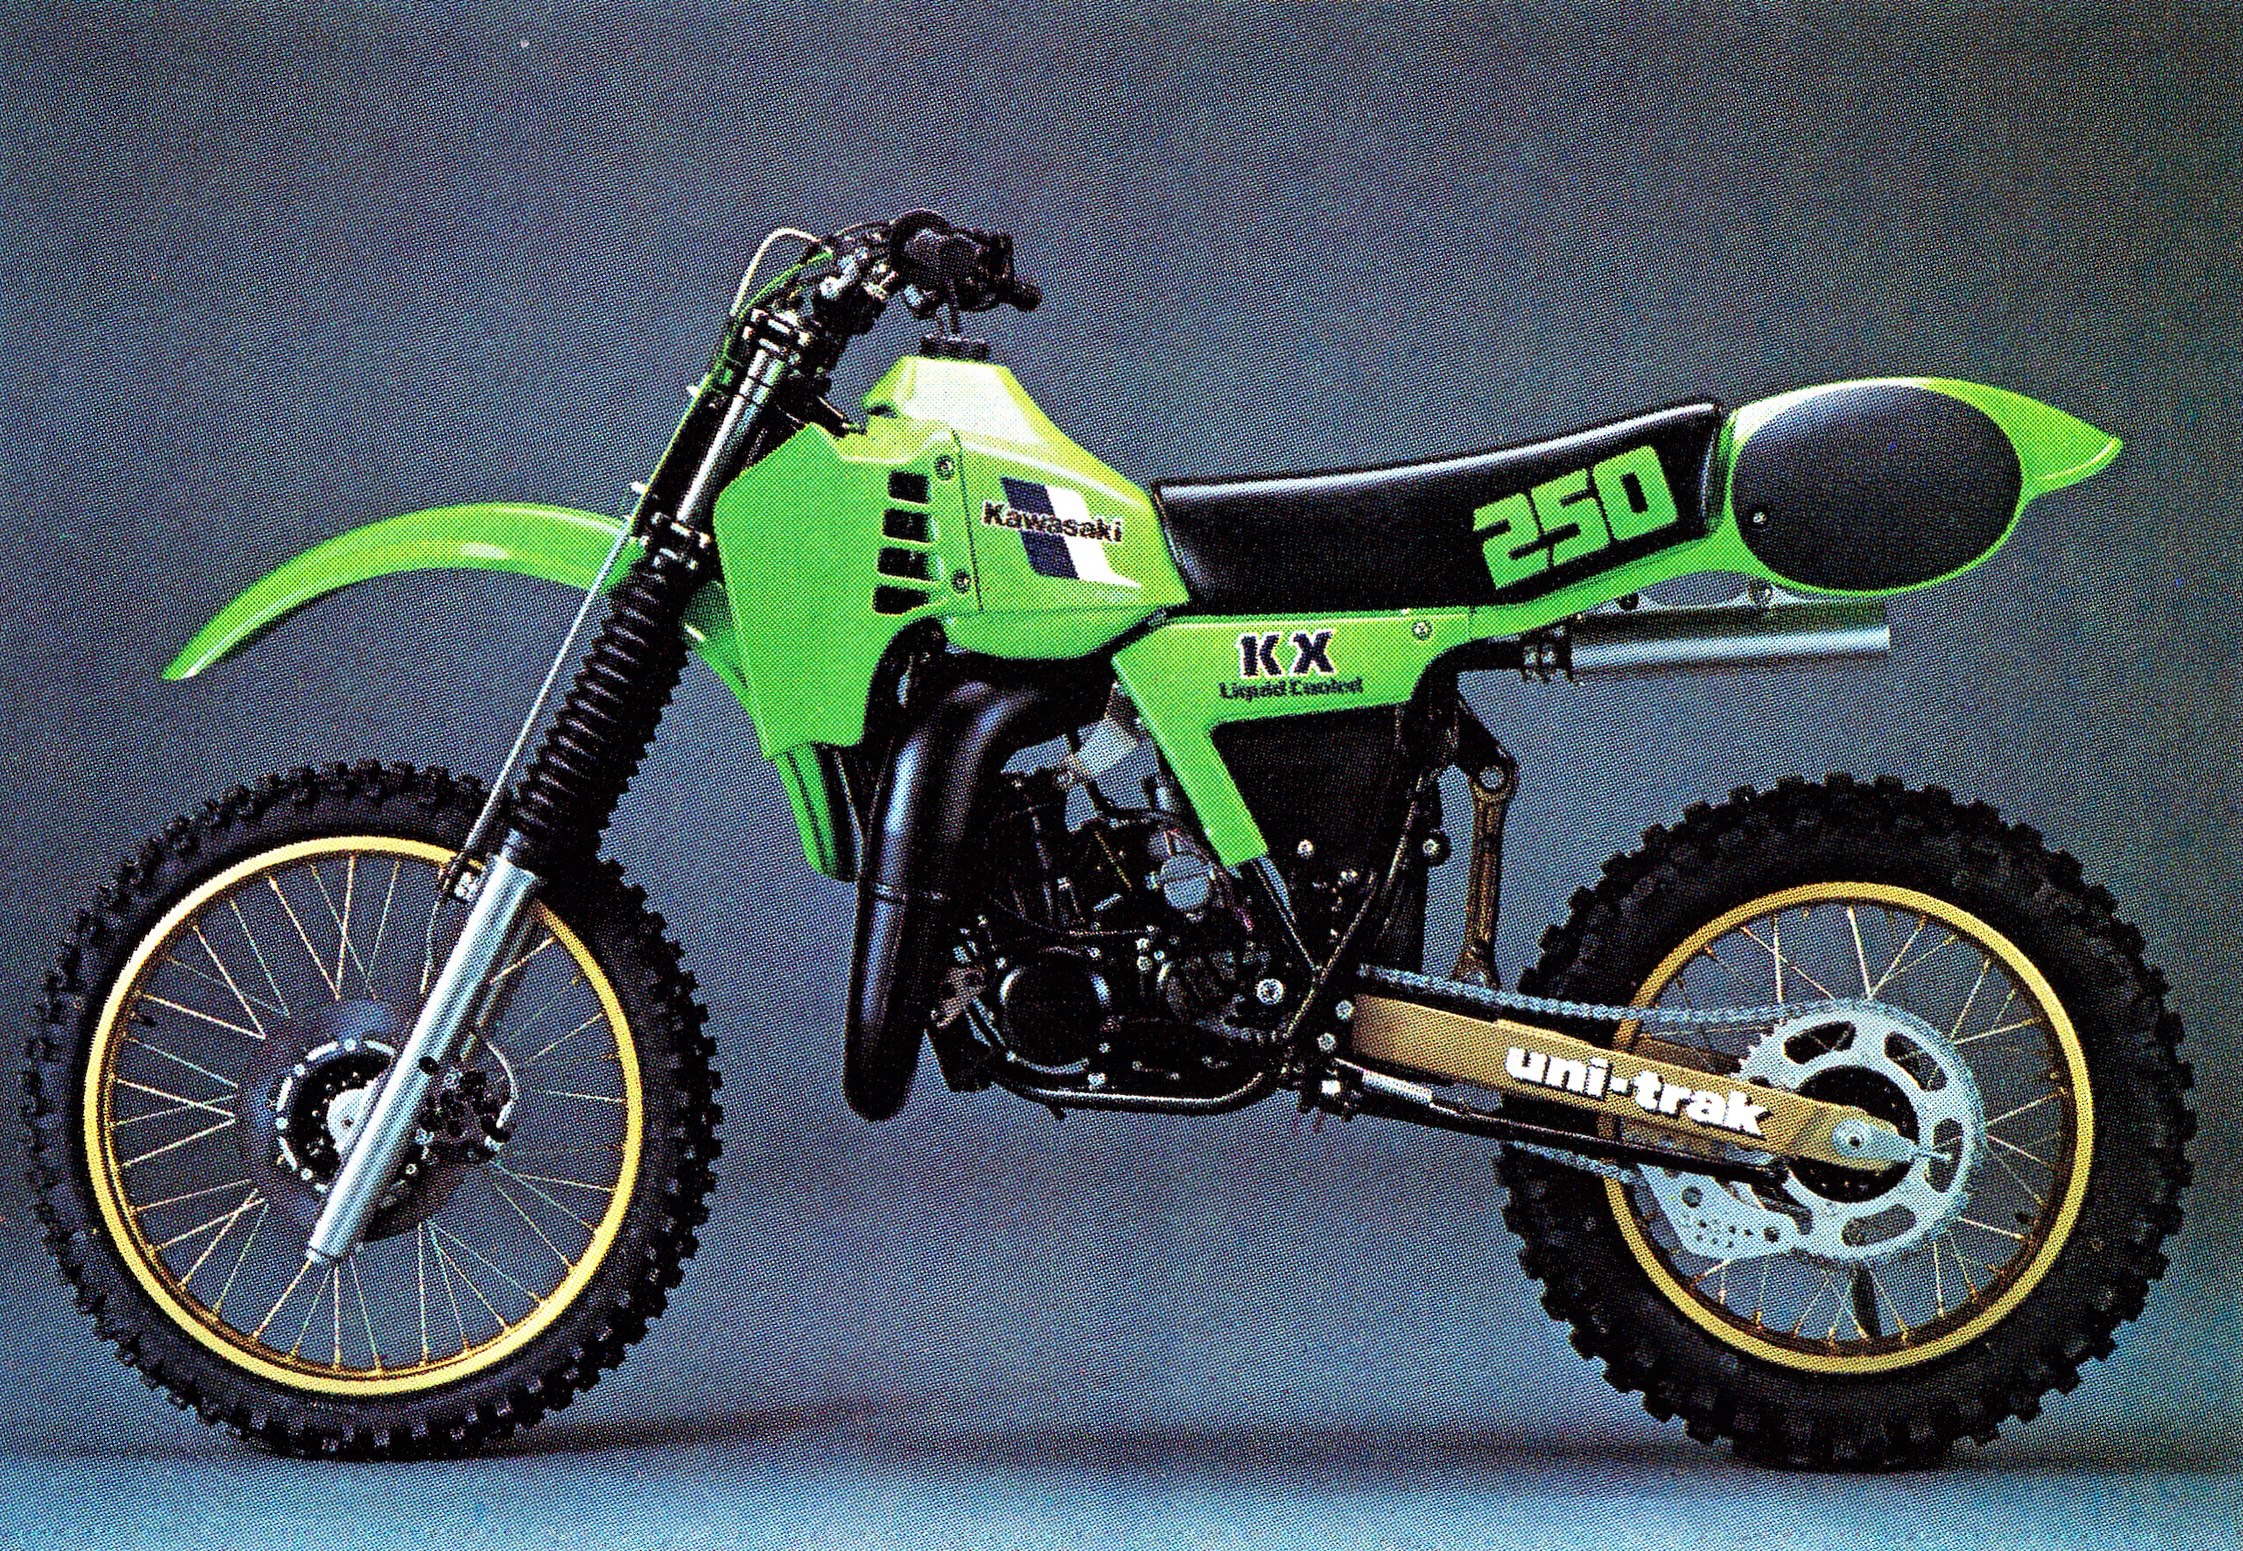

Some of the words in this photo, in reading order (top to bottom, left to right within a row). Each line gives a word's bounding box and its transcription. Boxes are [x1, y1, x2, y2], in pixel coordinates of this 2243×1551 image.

[982, 500, 1122, 542] Kawasaki
[1473, 445, 1678, 590] 250
[1219, 681, 1286, 703] Liquid
[1289, 677, 1364, 696] Cooled
[1505, 1046, 1772, 1140] uni-trak
